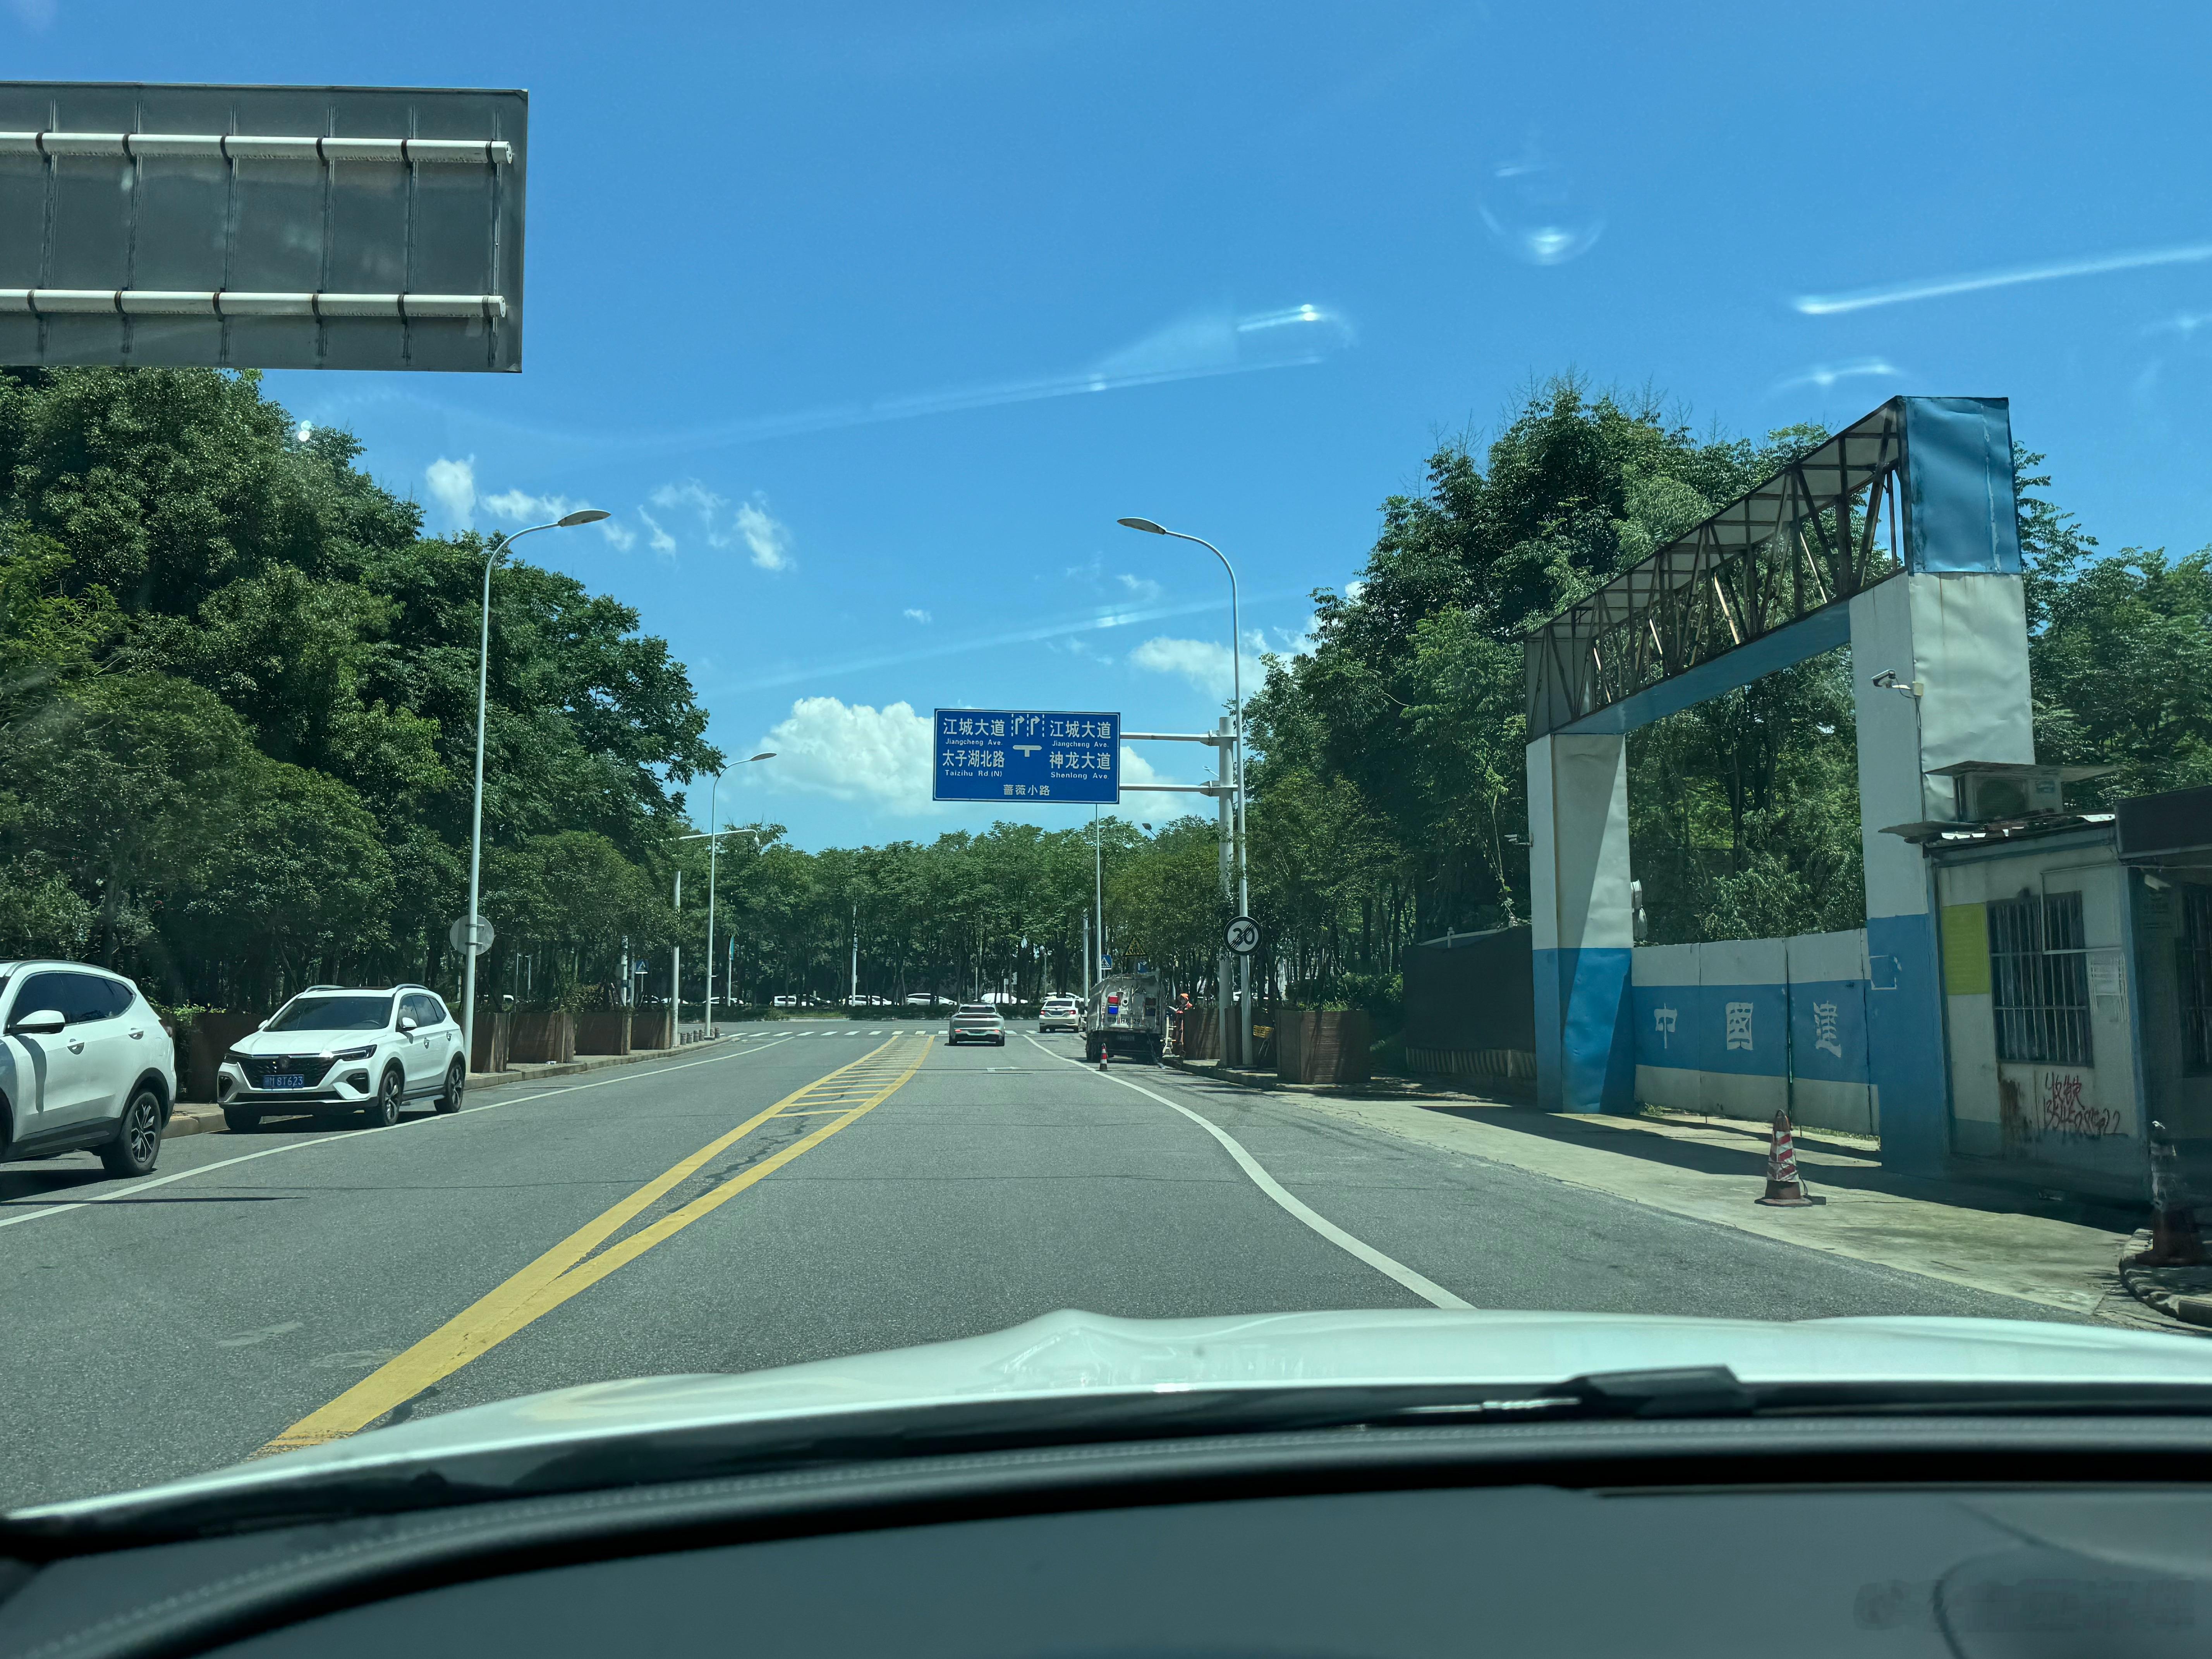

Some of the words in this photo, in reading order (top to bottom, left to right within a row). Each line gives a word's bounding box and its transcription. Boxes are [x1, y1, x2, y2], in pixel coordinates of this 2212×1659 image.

[943, 718, 1005, 737] 江城大道
[1050, 720, 1111, 739] 江城大道
[945, 738, 984, 746] Jiangcheng
[942, 749, 1005, 768] 太子湖北路
[1049, 751, 1111, 770] 神龙大道
[1051, 771, 1087, 780] Shenlong
[1003, 784, 1050, 796] 蔷薇小路
